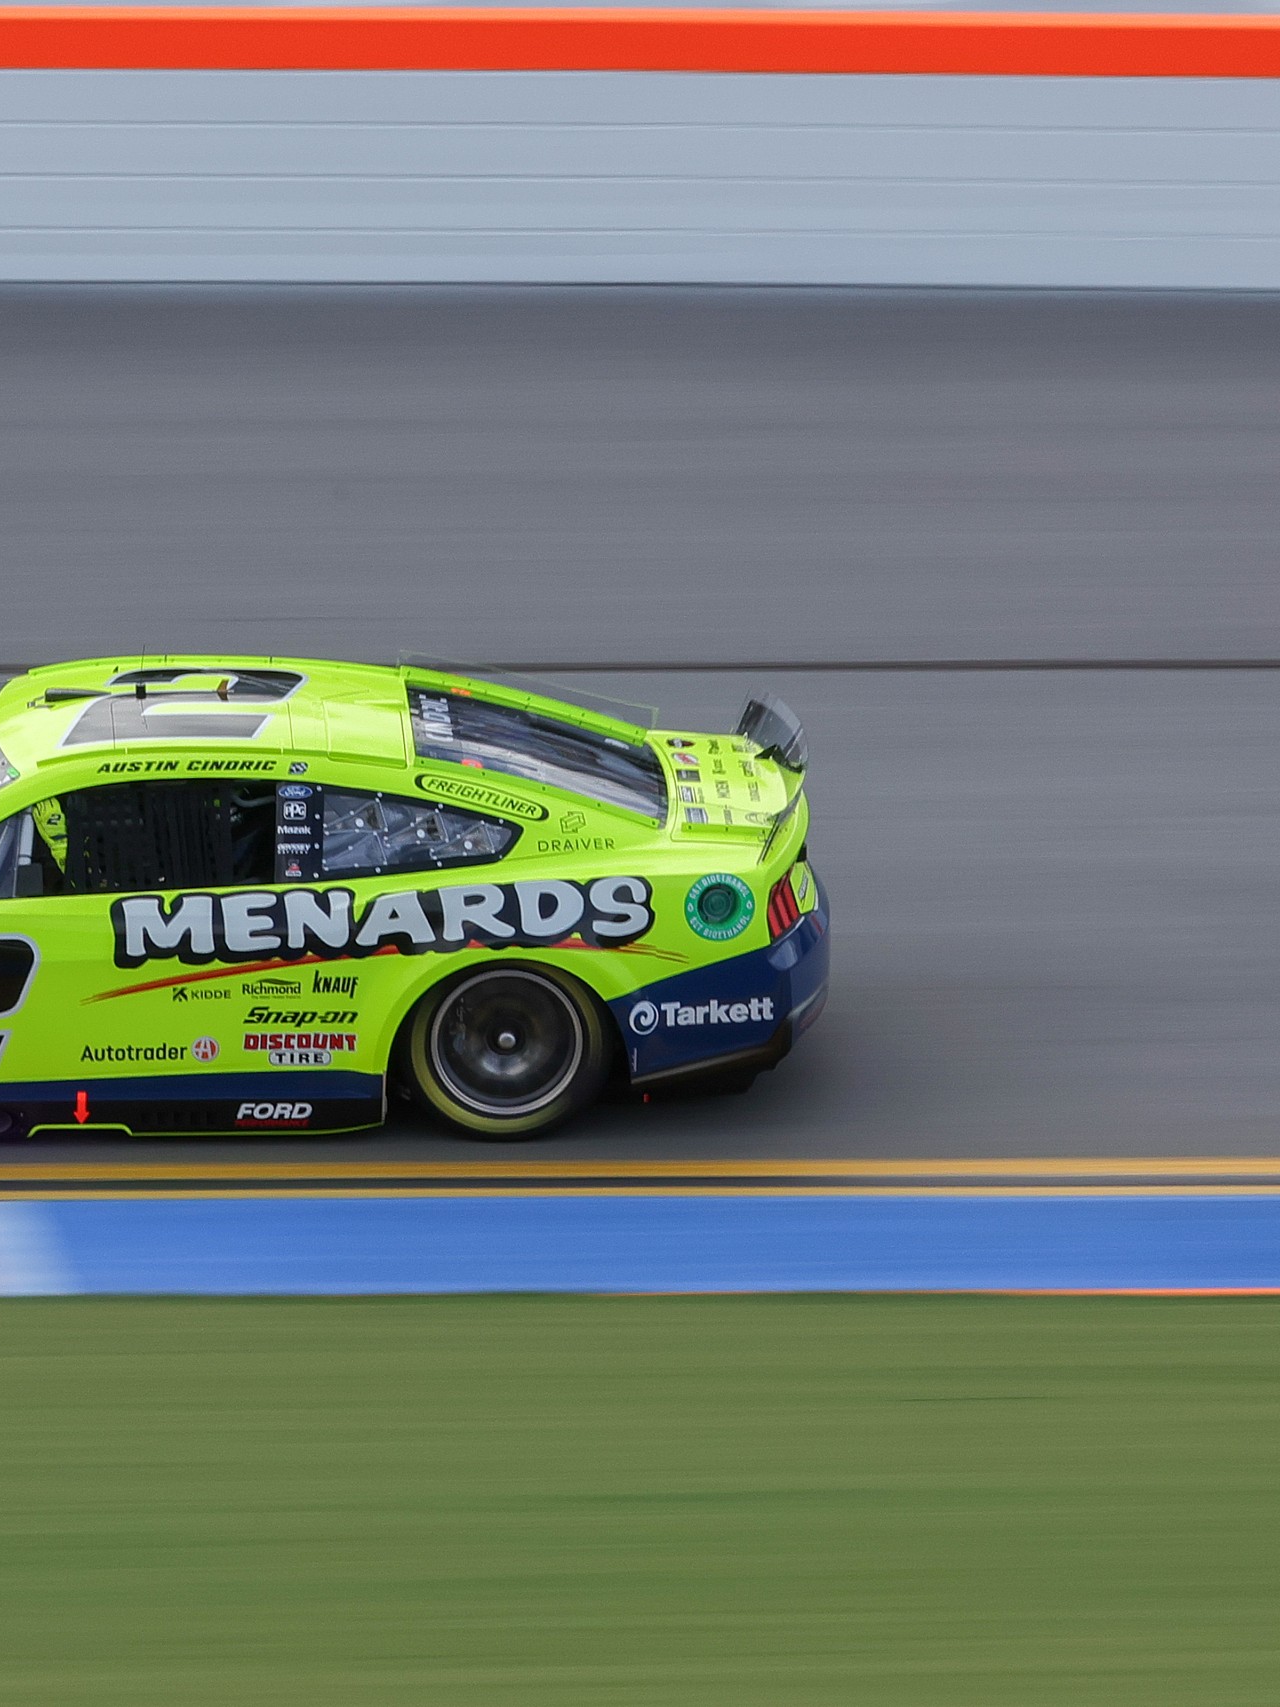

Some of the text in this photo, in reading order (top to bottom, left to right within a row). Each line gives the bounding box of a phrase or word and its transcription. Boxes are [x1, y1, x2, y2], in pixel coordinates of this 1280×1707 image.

[57, 667, 308, 748] 2
[97, 760, 277, 774] AUSTIN CINDRIC
[427, 778, 538, 816] FREIGHTLINER
[285, 802, 305, 818] PPG
[277, 825, 311, 834] Mazak
[538, 838, 615, 852] DRAIVER
[114, 876, 652, 962] MENARDS
[191, 990, 232, 999] KIDDE
[242, 982, 301, 995] Richmond
[243, 1006, 358, 1027] Snap-on
[661, 997, 773, 1027] Tarkett
[243, 1033, 358, 1051] DISCOUNT
[81, 1043, 187, 1062] Autotrader
[275, 1053, 324, 1063] TIRE
[236, 1103, 313, 1119] FORD
